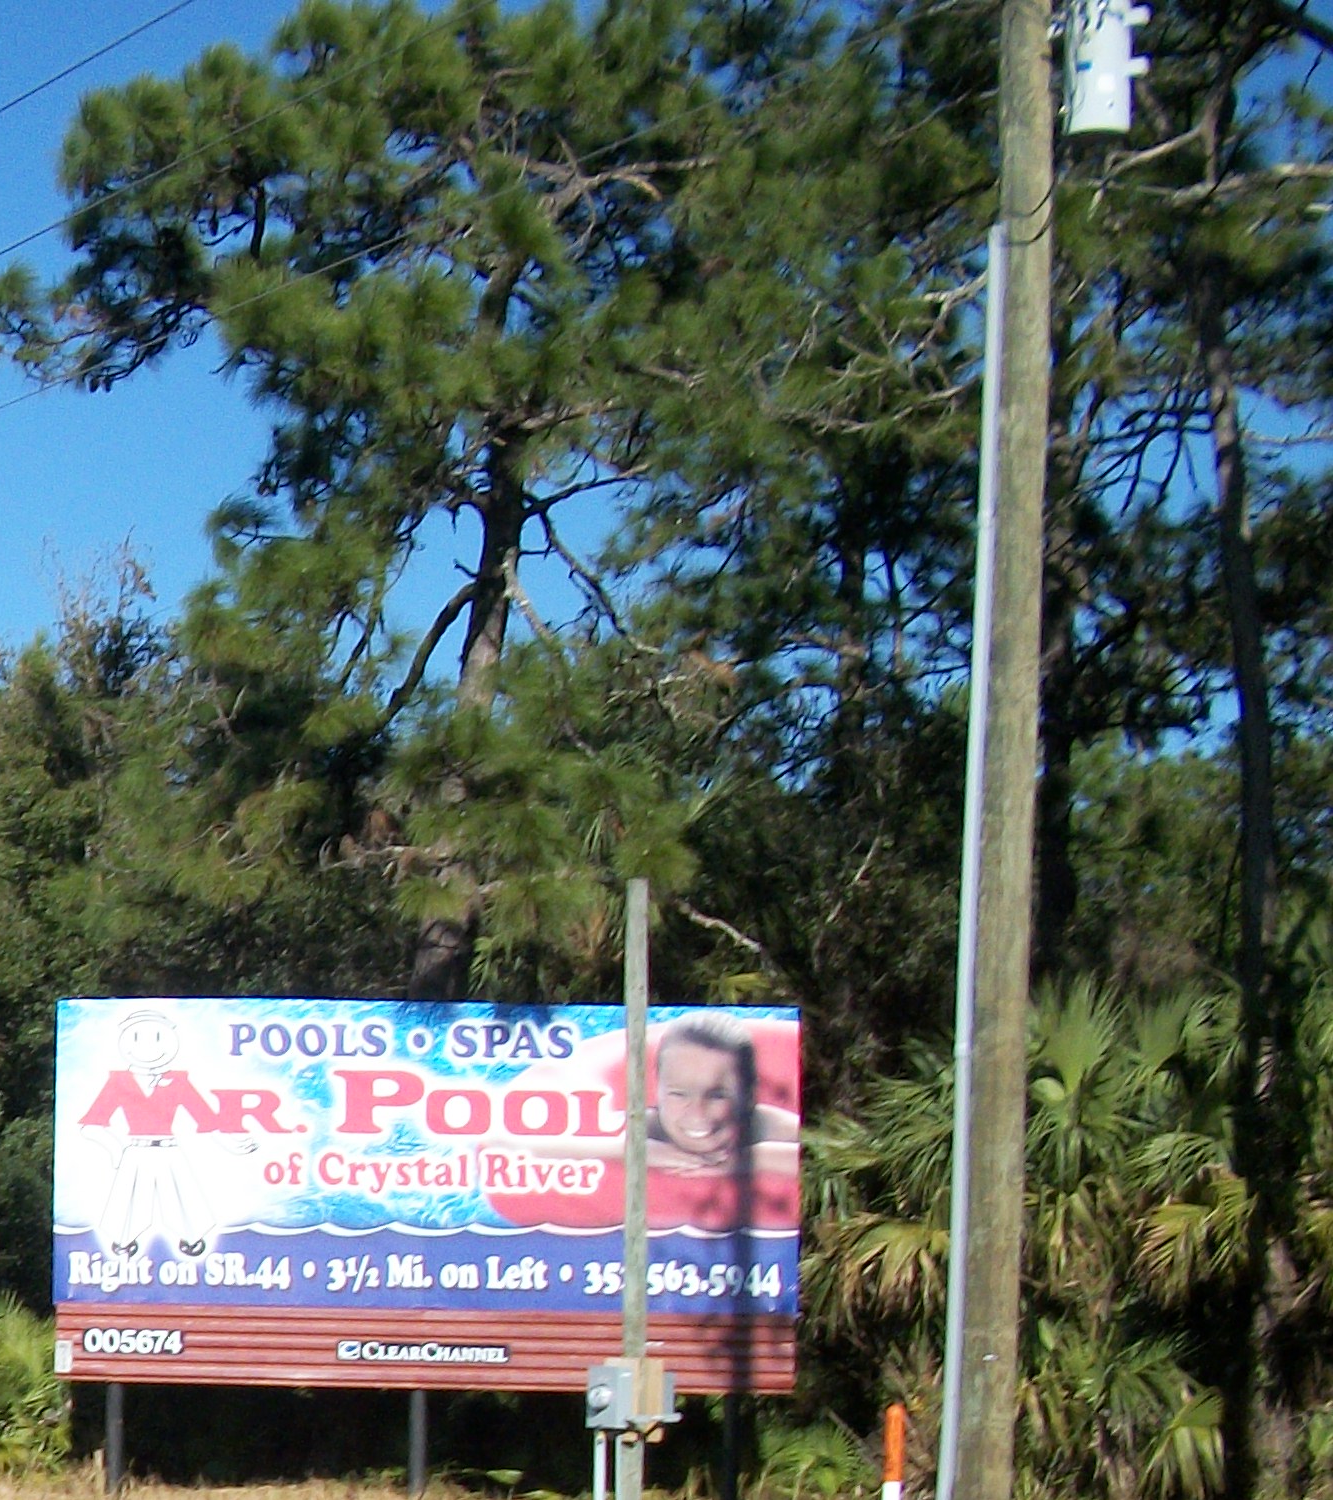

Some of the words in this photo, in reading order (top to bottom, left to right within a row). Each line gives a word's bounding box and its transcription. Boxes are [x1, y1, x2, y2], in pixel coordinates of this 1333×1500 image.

[229, 1023, 388, 1057] POOLS
[451, 1024, 575, 1059] SPAS
[77, 1070, 308, 1135] MR.
[333, 1070, 626, 1137] POOL
[263, 1152, 303, 1185] of
[318, 1153, 470, 1193] Crystal
[485, 1154, 600, 1189] River
[68, 1252, 153, 1292] Right
[158, 1261, 198, 1286] on
[204, 1253, 291, 1290] SR.44
[386, 1254, 433, 1288] Mi.
[440, 1261, 479, 1288] on
[486, 1256, 548, 1290] Left
[583, 1259, 782, 1297] 35563.5944
[84, 1328, 183, 1354] 005674
